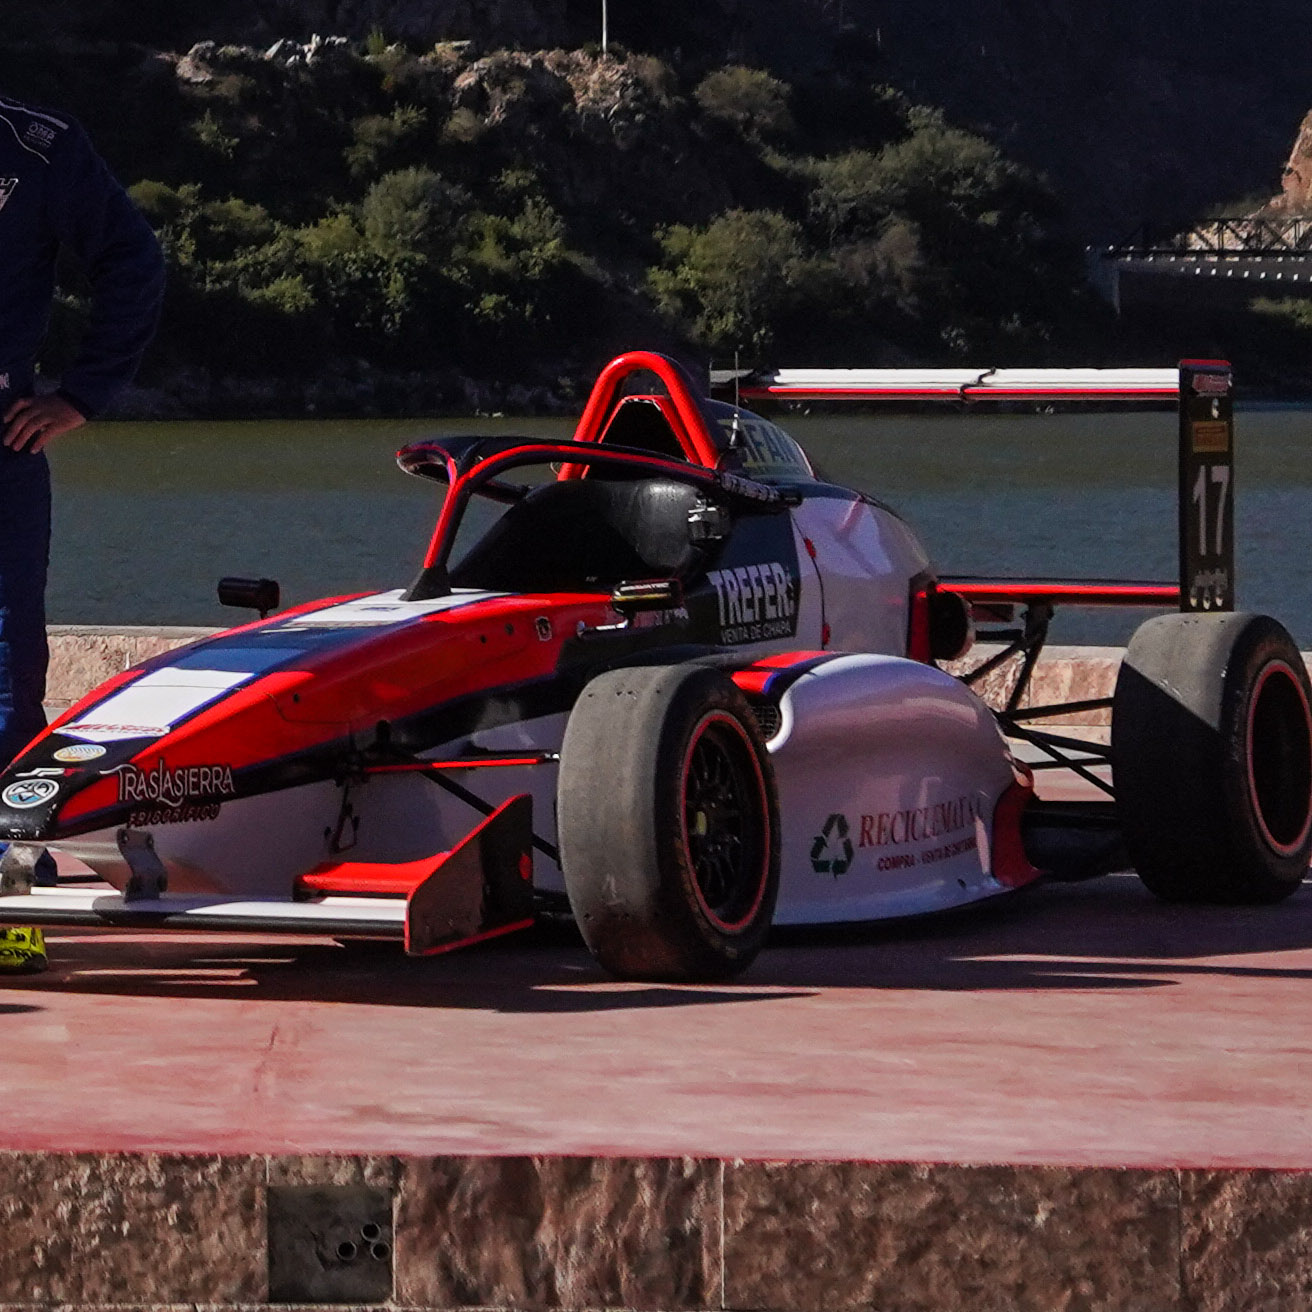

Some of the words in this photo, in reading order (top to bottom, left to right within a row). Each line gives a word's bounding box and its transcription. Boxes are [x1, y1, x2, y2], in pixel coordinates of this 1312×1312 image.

[28, 122, 57, 141] OMP
[1192, 464, 1230, 557] 17
[705, 562, 790, 627] TREFER
[99, 758, 237, 808] TRASLASIERRA
